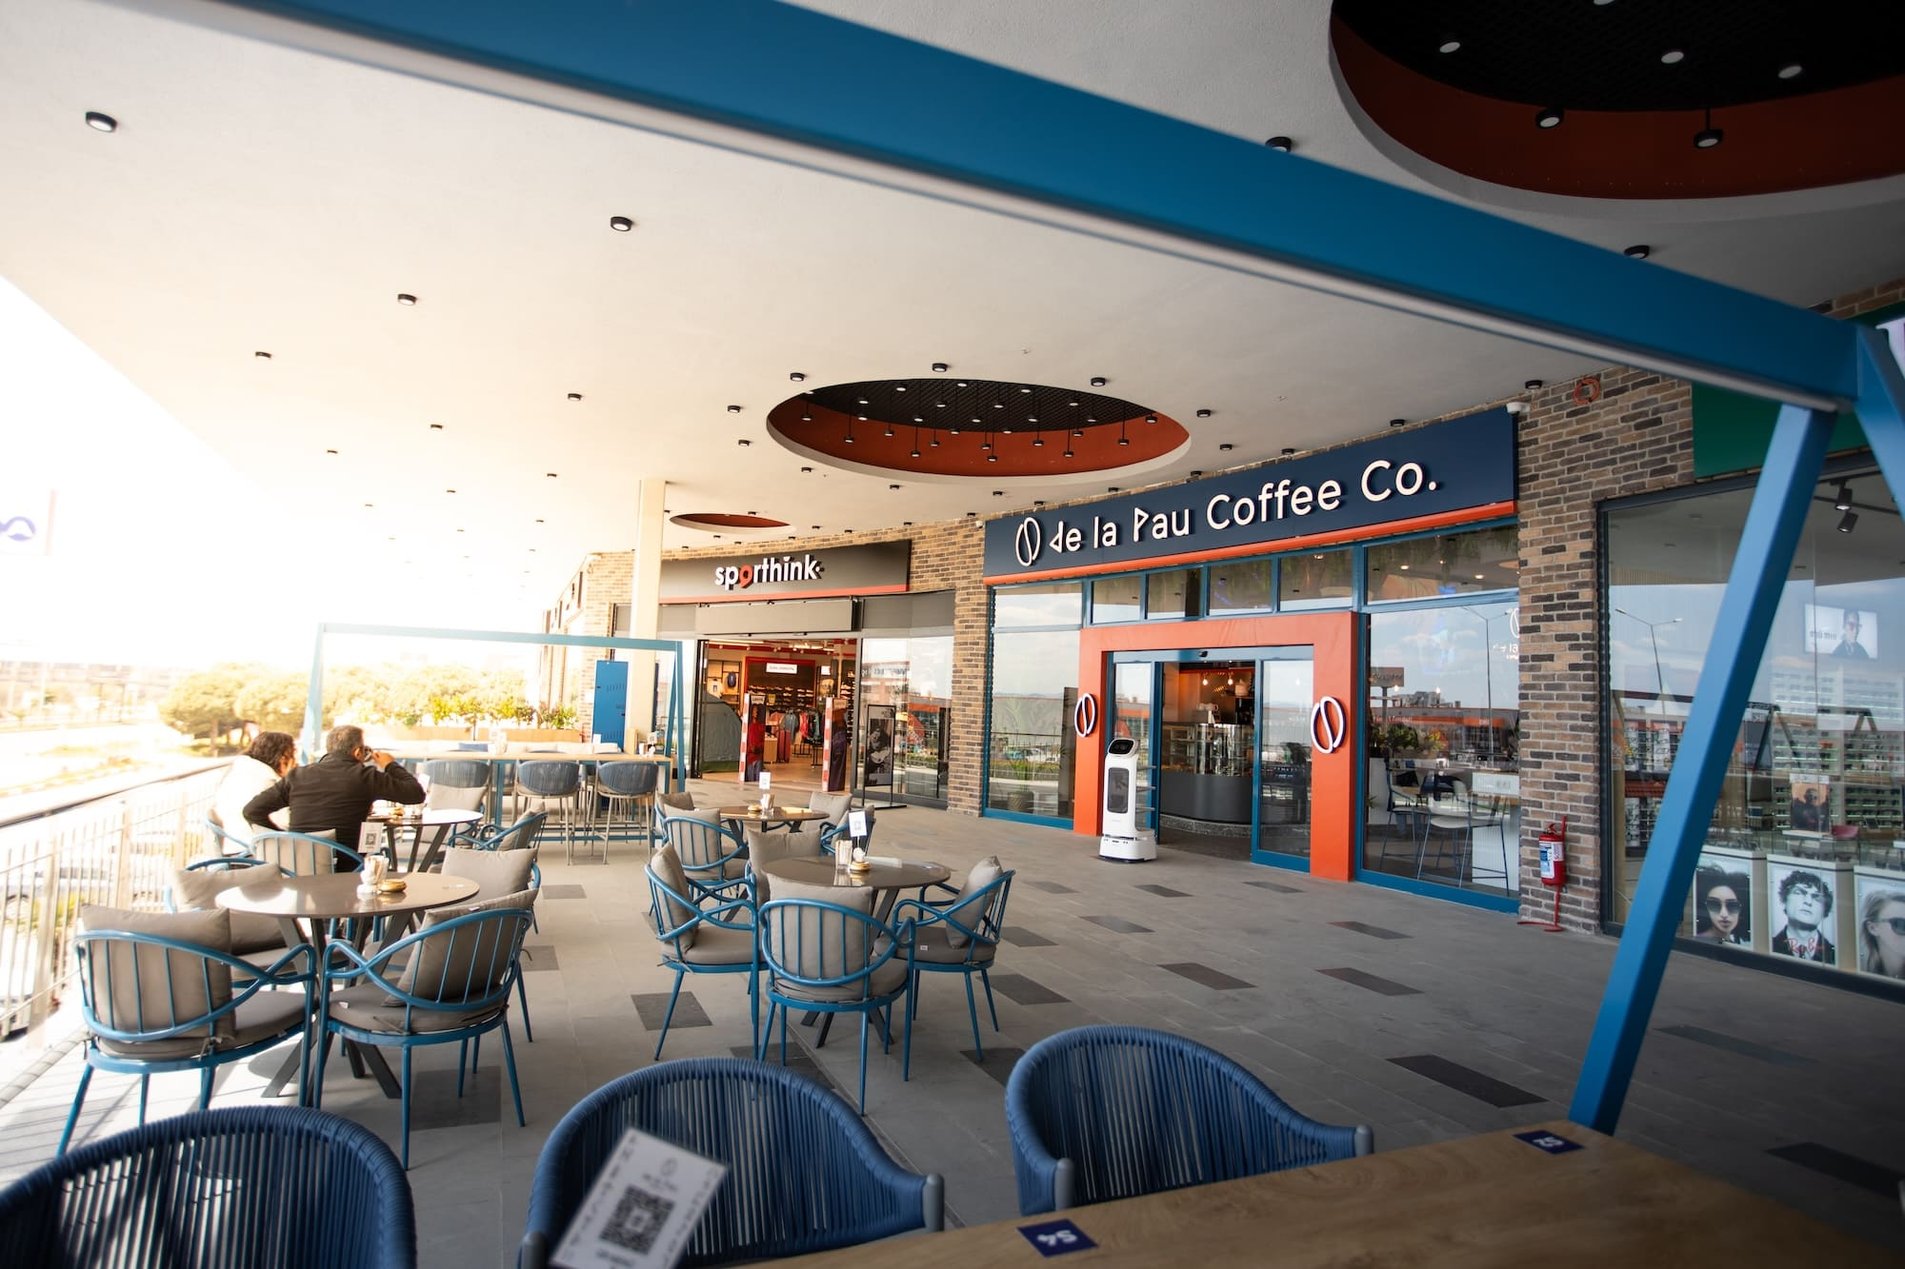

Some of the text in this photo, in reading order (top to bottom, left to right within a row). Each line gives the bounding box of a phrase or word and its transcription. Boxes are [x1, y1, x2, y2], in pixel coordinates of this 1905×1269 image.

[1049, 459, 1438, 552] de la Pau Coffee Co.
[714, 554, 820, 591] sporthink
[1037, 1229, 1078, 1247] S4
